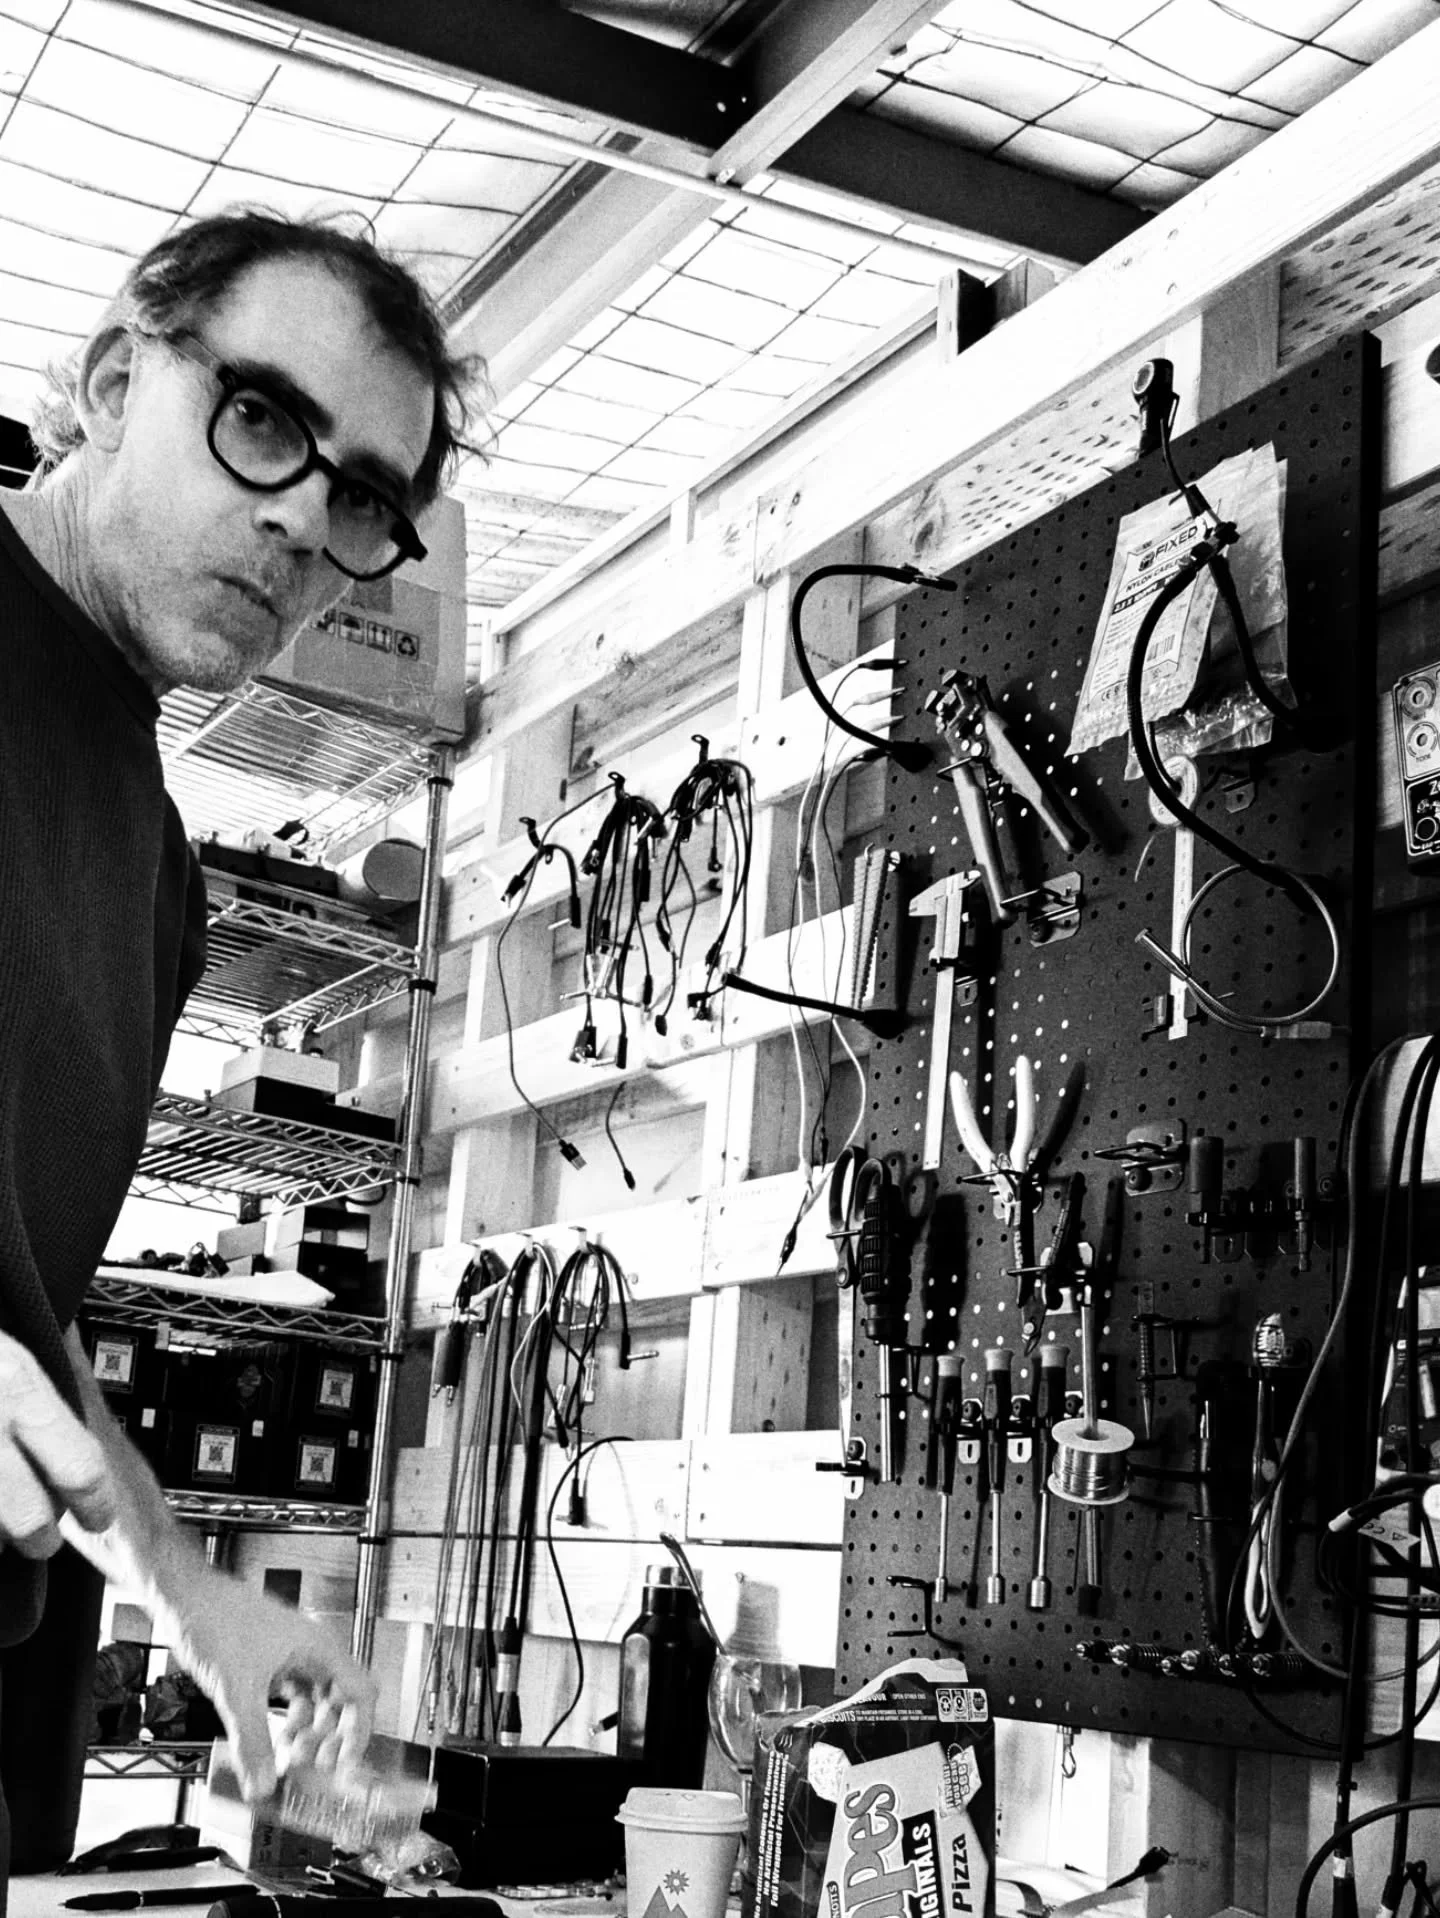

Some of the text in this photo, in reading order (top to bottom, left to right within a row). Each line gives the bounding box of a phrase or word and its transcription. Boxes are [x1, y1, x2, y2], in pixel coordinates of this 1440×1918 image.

[772, 1832, 783, 1885] Wrapped
[912, 1823, 939, 1918] IGINALS
[951, 1833, 973, 1913] Pizza
